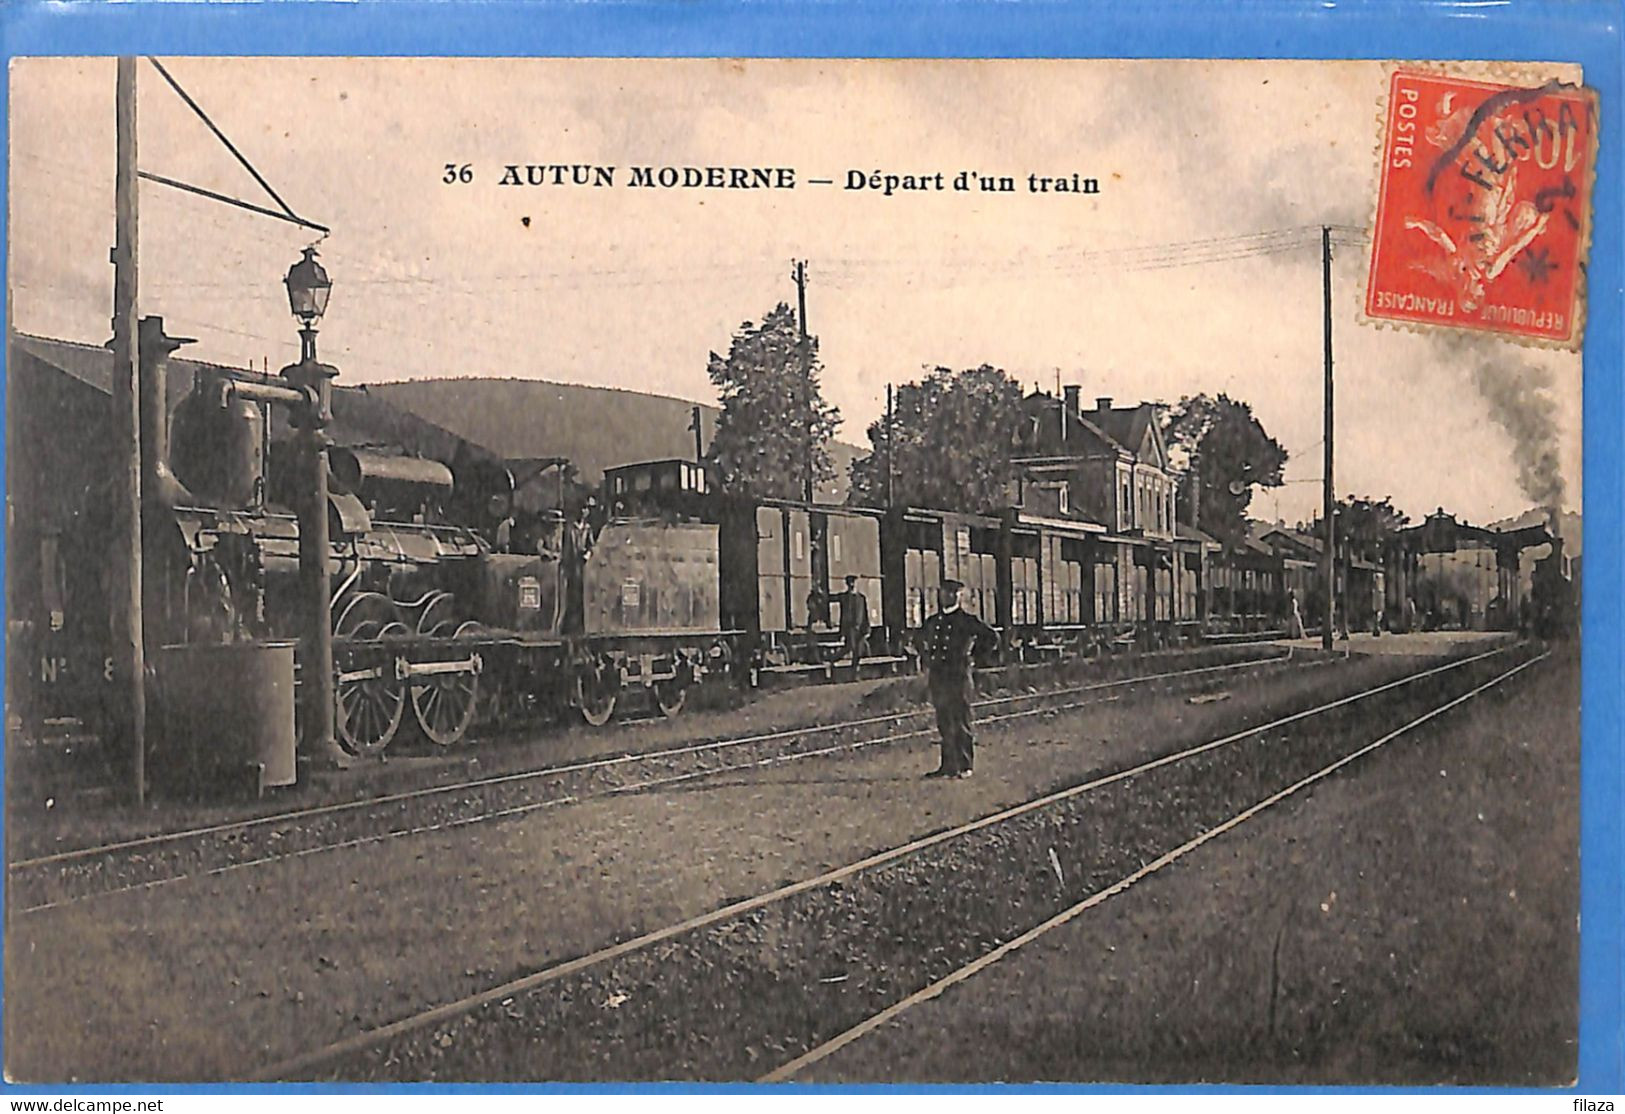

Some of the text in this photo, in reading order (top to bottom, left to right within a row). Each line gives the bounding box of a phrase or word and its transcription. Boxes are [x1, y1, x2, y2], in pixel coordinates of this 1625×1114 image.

[1394, 89, 1419, 169] POSTES
[443, 163, 472, 184] 36
[499, 166, 616, 187] AUTUN
[628, 168, 796, 189] MODERNE
[845, 170, 944, 196] Départ
[954, 172, 1015, 192] d'un
[1028, 174, 1100, 194] train
[1375, 291, 1455, 316] FRANÇAISE
